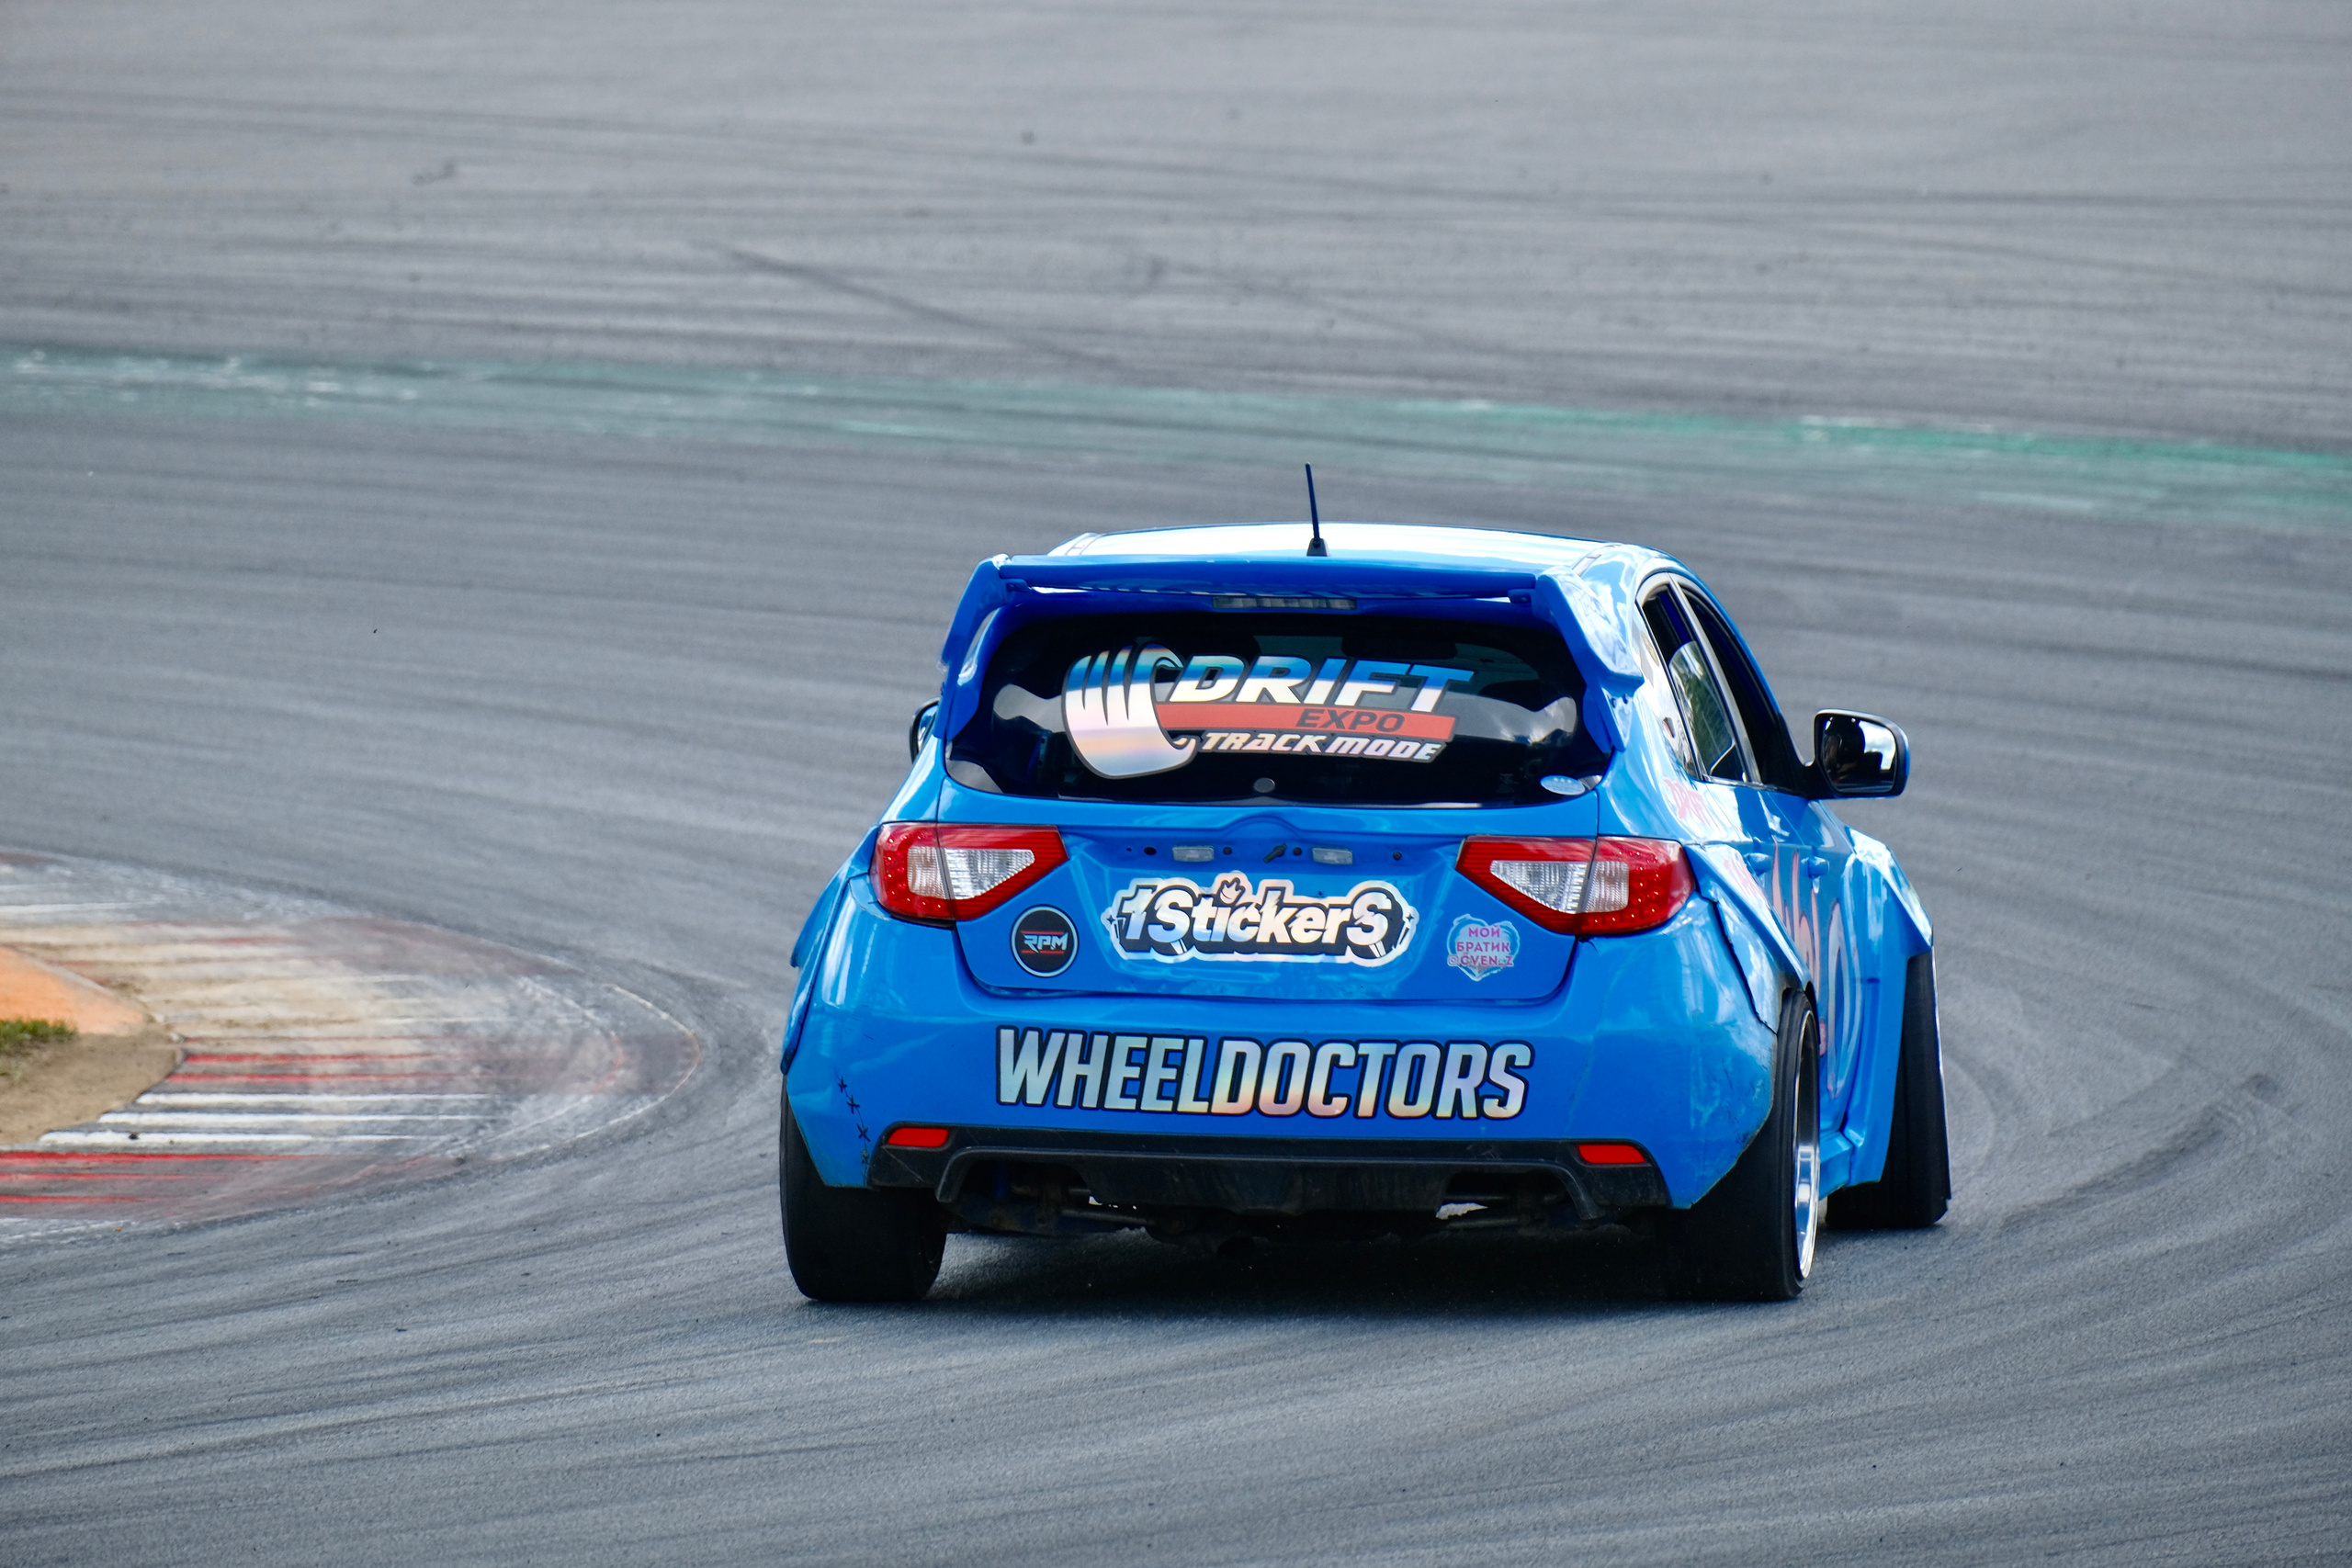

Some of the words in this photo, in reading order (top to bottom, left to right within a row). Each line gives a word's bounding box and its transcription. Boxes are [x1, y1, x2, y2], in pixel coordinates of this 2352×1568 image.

[1169, 655, 1476, 713] DRIFT
[1295, 708, 1406, 733] EXPO
[1202, 731, 1327, 754] TRACK
[1324, 734, 1443, 761] MODE
[1023, 931, 1069, 953] RPM
[1467, 924, 1501, 938] МОЙ
[1456, 941, 1511, 953] БРАТИК
[998, 1027, 1536, 1120] WHEELDOCTORS
